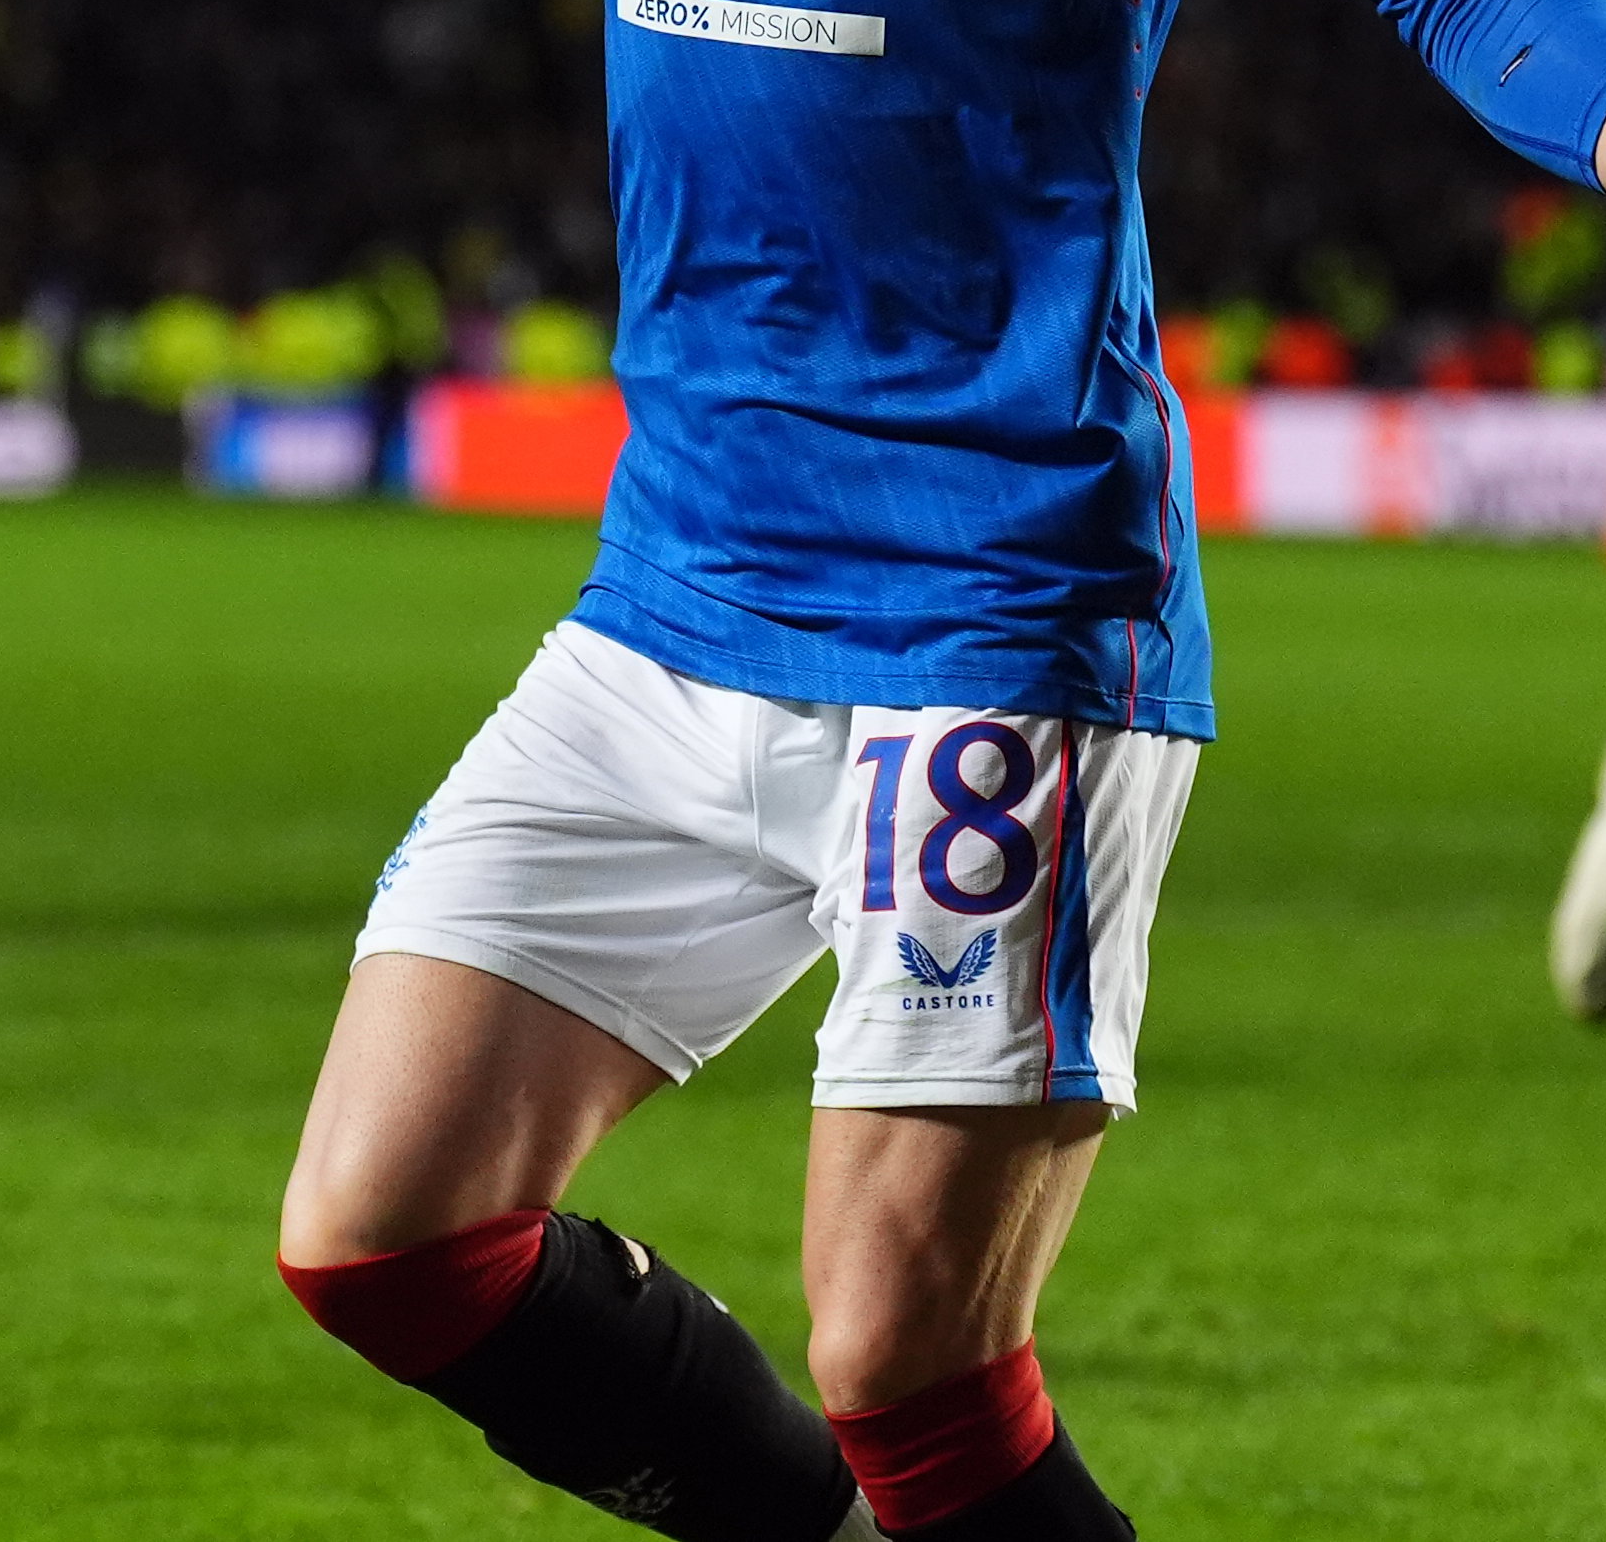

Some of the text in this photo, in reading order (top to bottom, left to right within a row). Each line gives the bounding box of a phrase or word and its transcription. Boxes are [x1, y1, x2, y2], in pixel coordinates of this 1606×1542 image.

[720, 7, 837, 45] MISSION
[856, 721, 1038, 915] 18
[902, 994, 996, 1010] CASTORE
